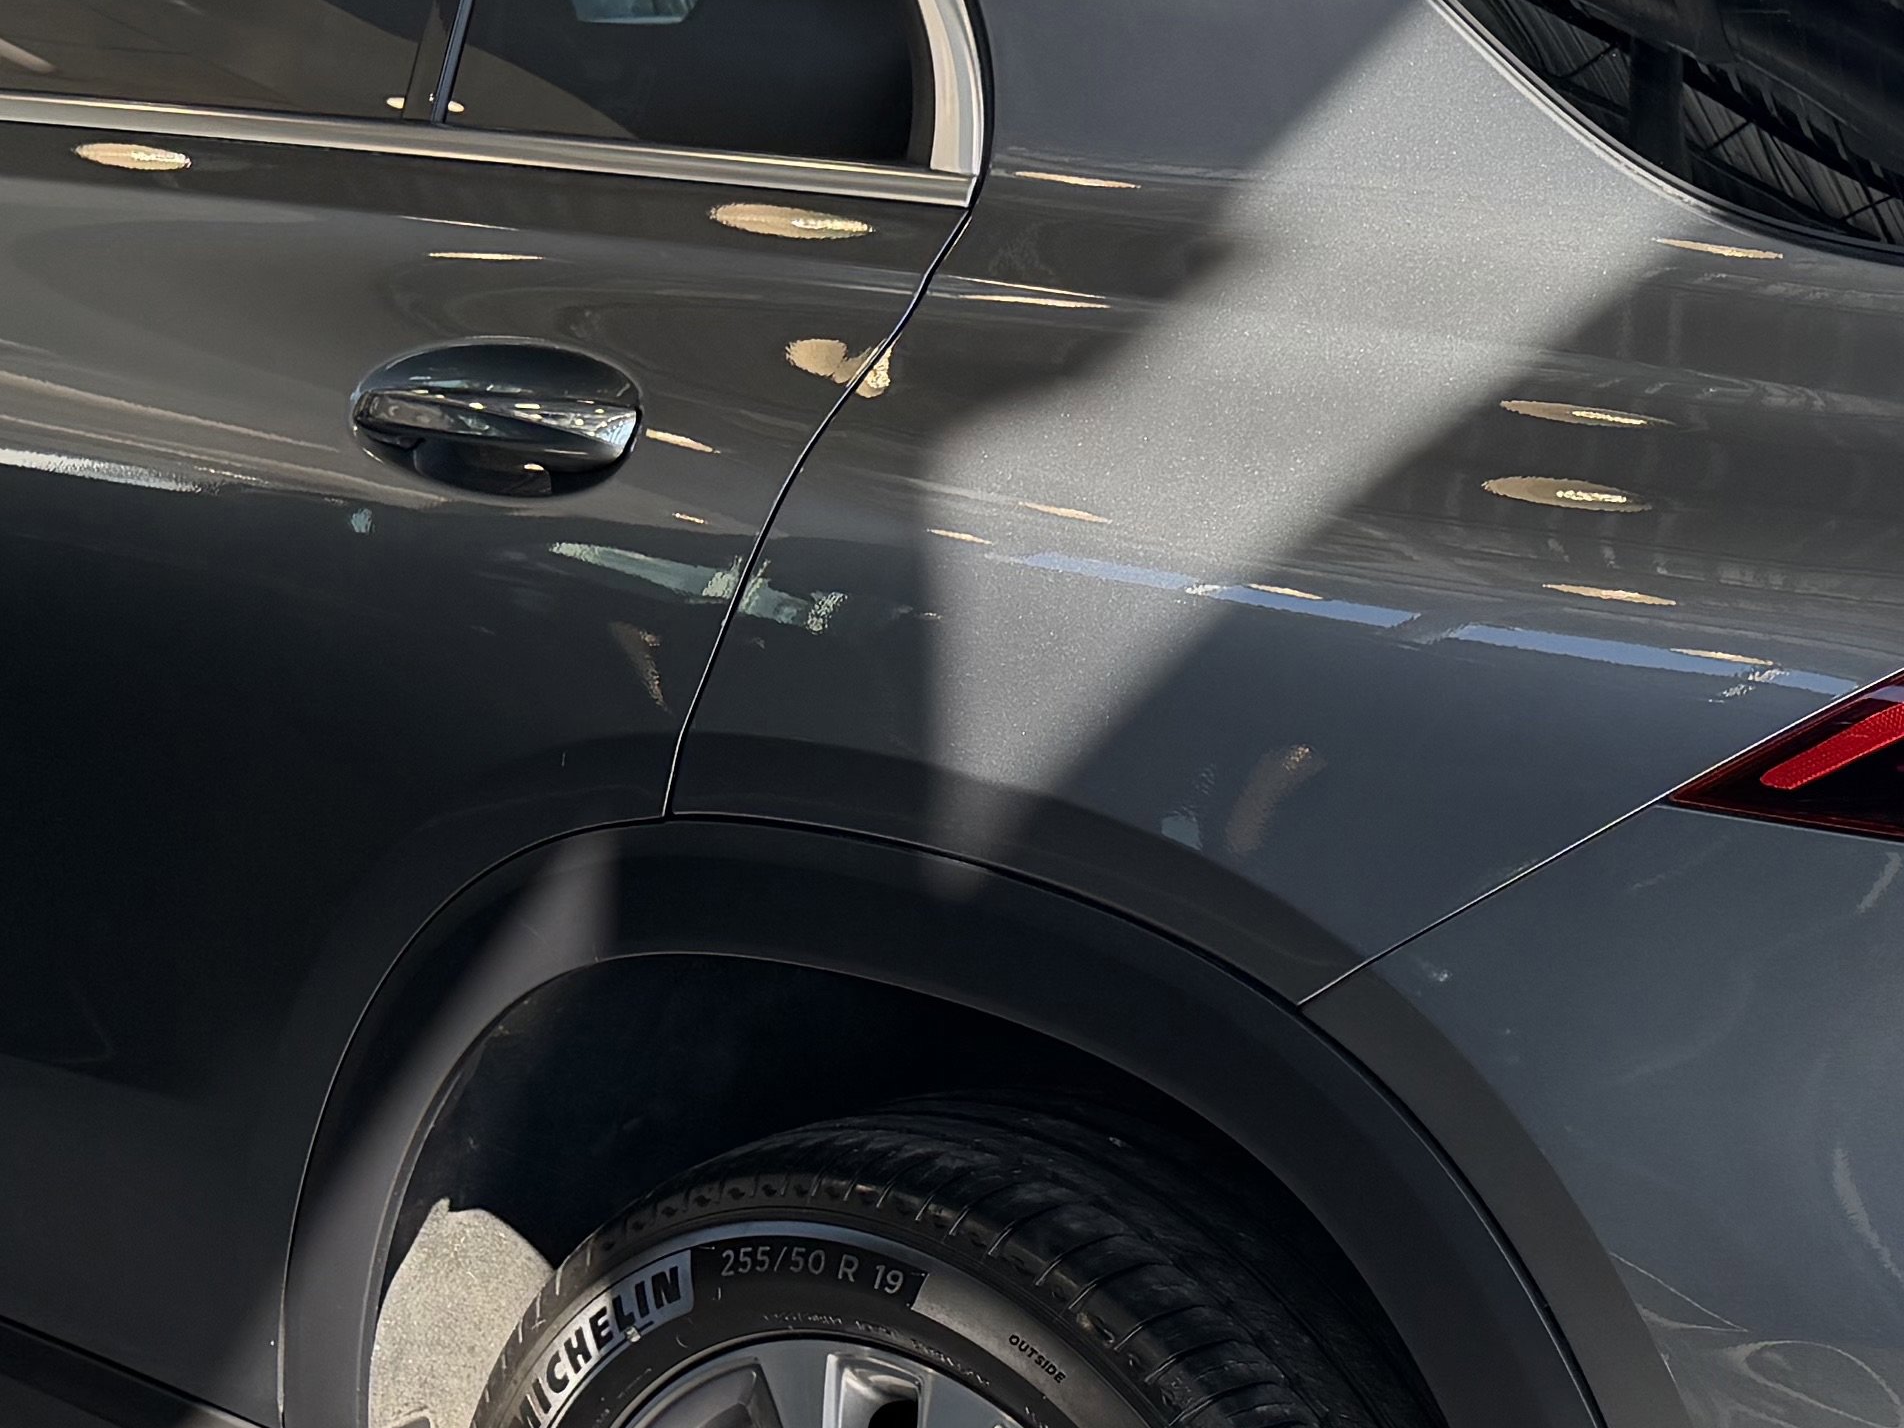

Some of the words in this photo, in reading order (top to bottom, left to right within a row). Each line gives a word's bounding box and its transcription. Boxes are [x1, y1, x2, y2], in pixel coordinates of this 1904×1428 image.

[720, 1245, 826, 1277] 255/50
[837, 1253, 860, 1283] R
[872, 1263, 905, 1294] 19
[1008, 1333, 1067, 1384] OUTSIDE
